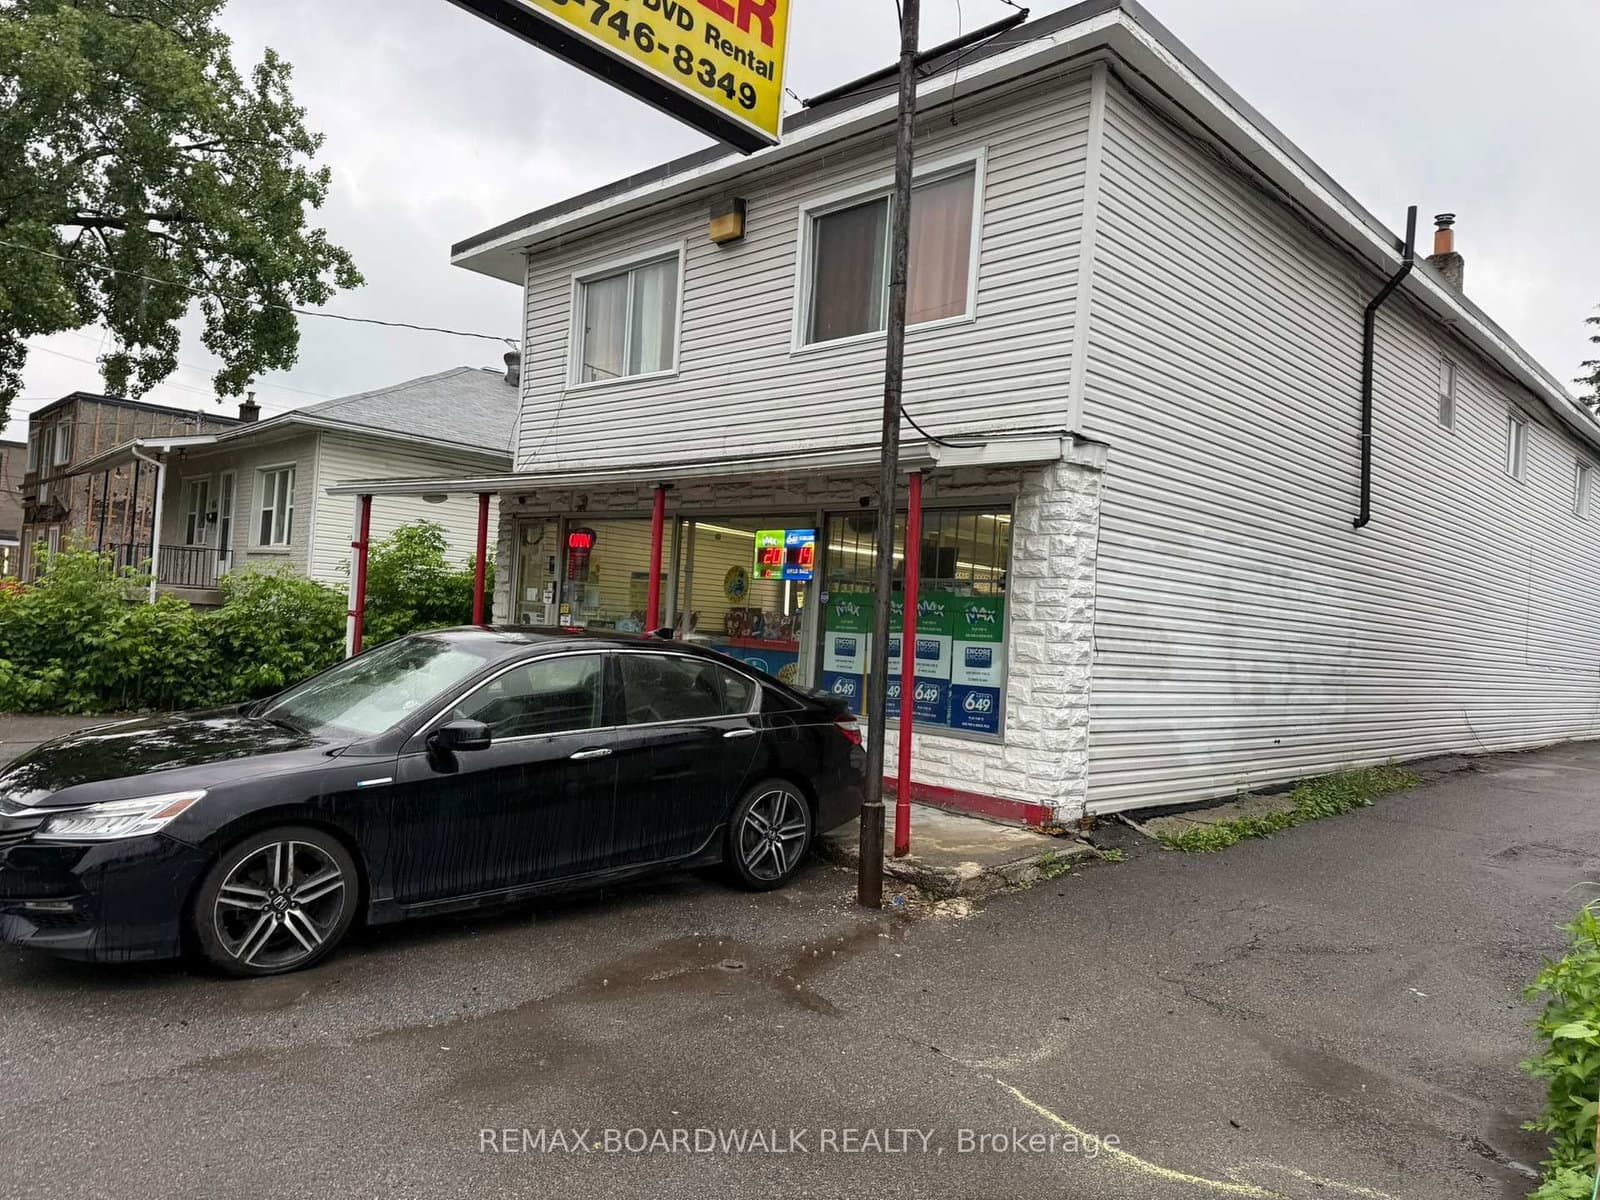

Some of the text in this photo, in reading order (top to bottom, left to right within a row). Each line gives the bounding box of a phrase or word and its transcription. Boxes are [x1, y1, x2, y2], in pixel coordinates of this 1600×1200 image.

[697, 0, 776, 49] R
[704, 22, 775, 81] Rental
[916, 639, 940, 649] ENCORE
[966, 647, 992, 657] ENCORE
[833, 679, 854, 695] 649
[887, 685, 901, 698] 49
[914, 684, 938, 702] 649
[965, 693, 991, 712] 649
